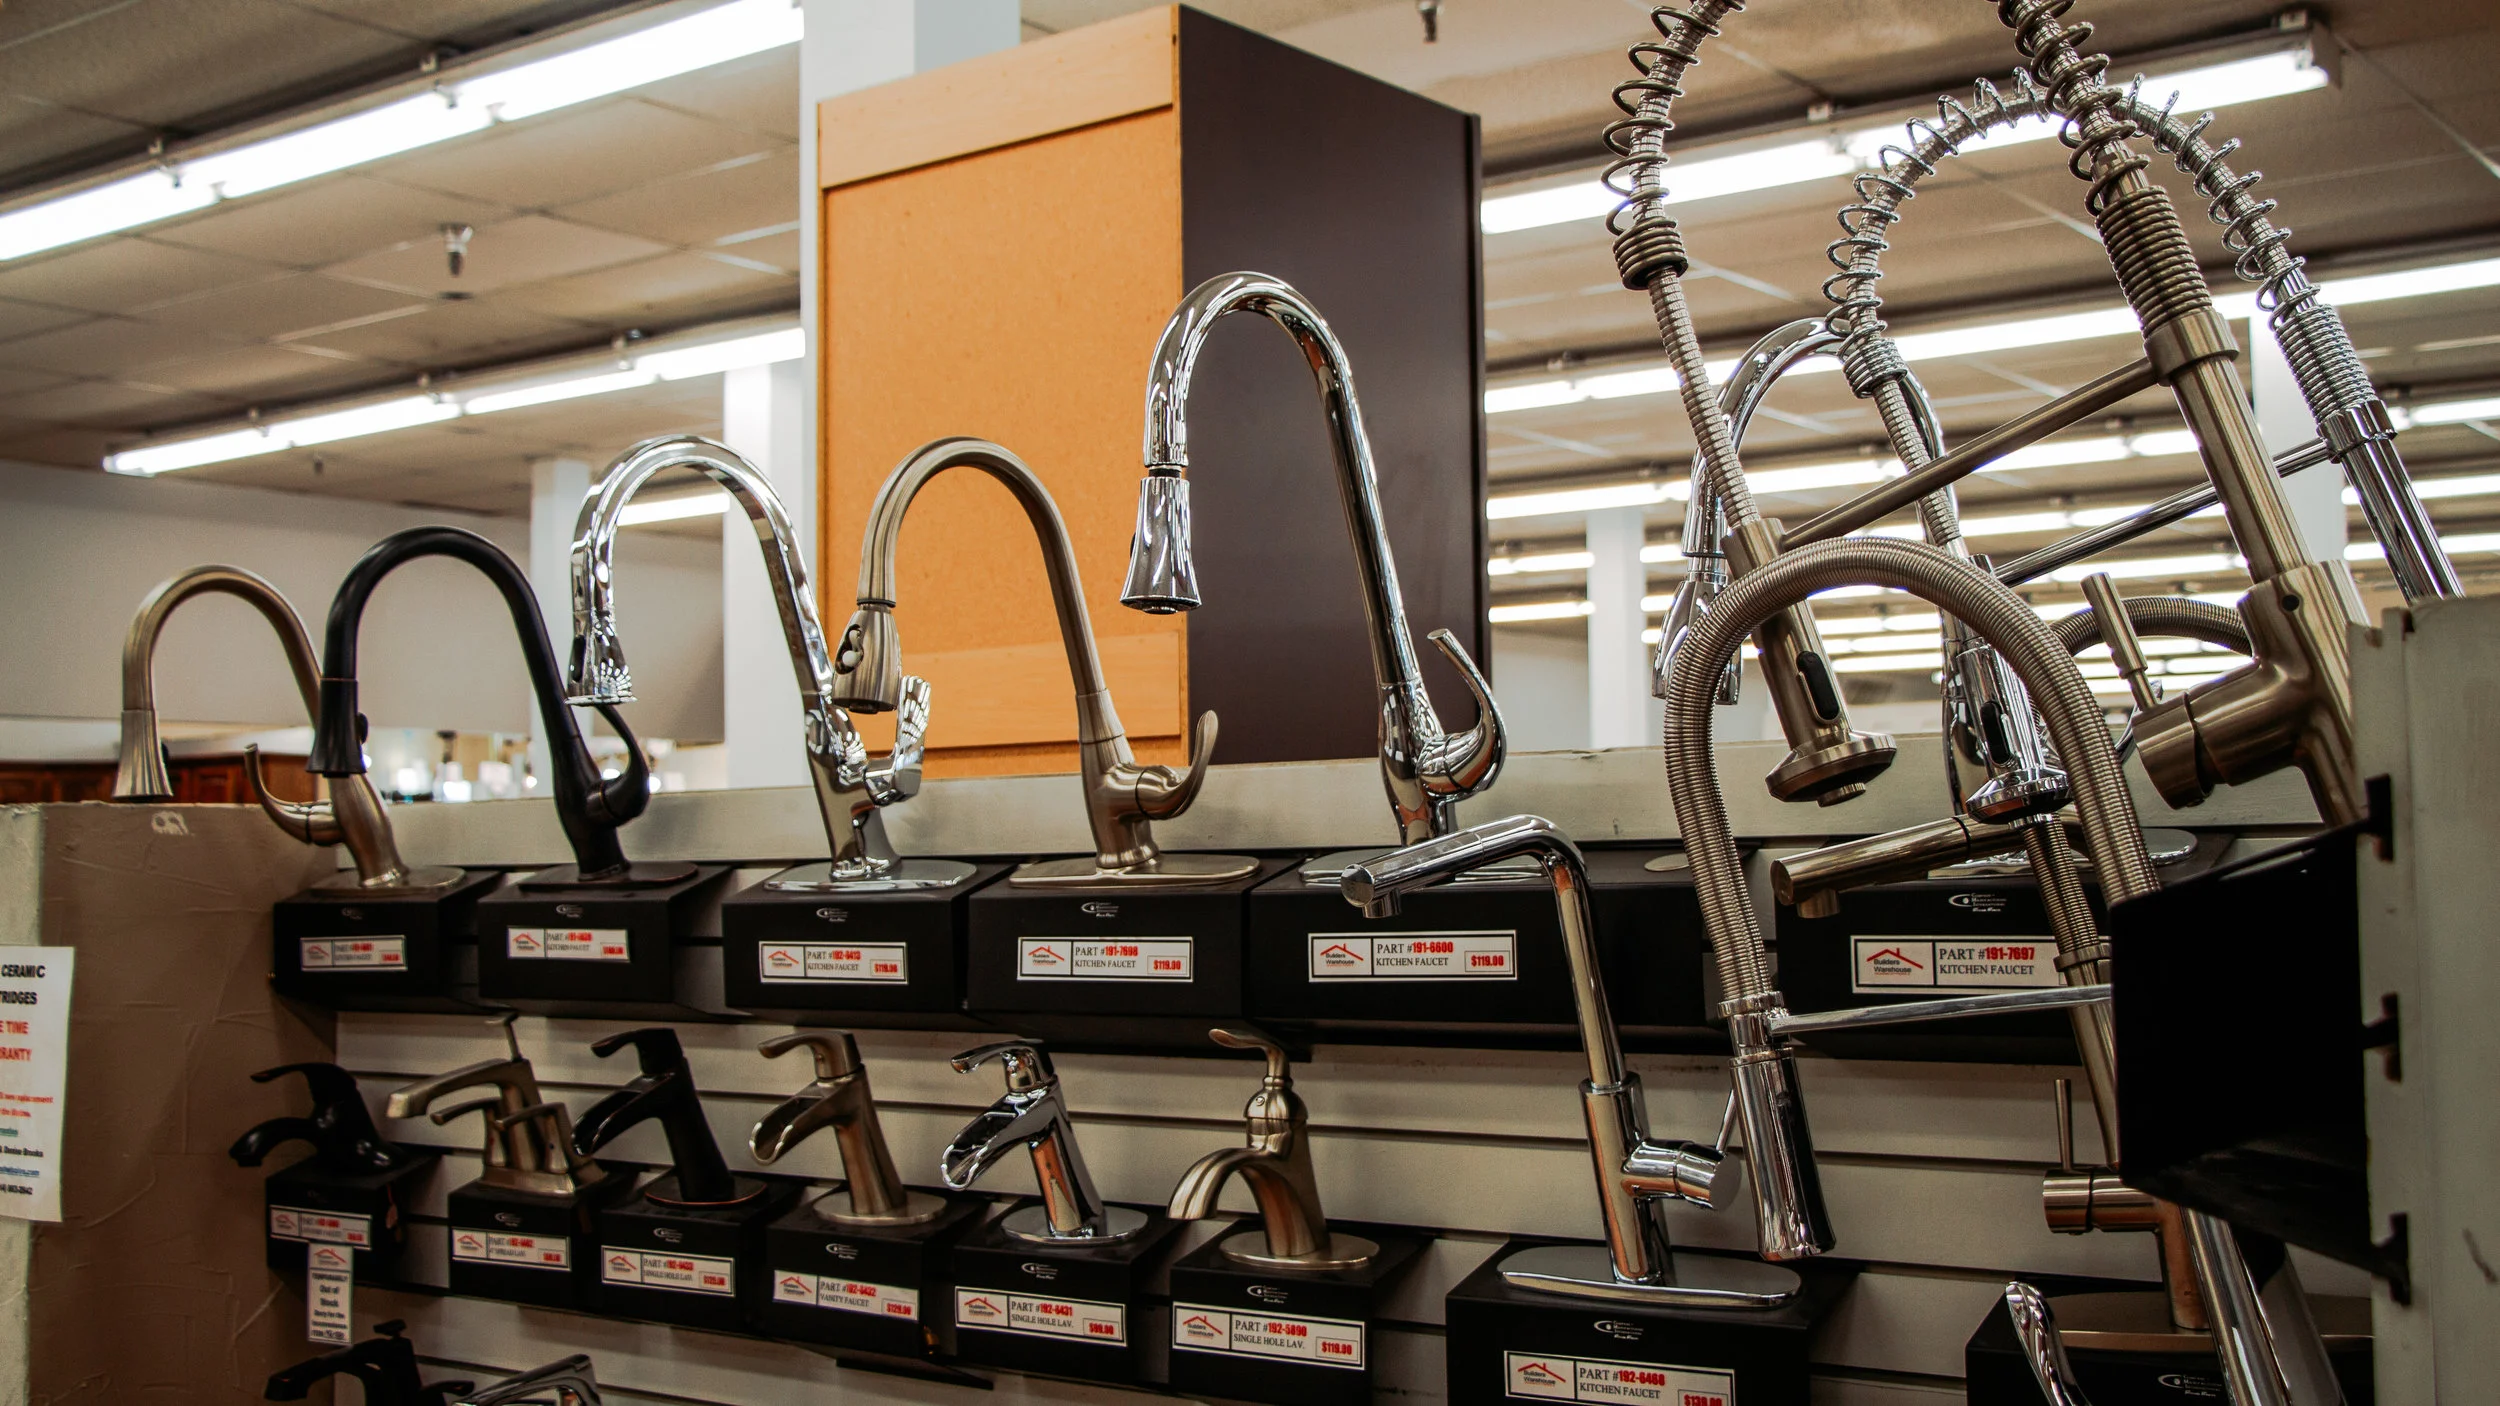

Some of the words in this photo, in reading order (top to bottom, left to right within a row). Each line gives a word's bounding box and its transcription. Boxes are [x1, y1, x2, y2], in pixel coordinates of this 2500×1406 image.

[1075, 947, 1098, 956] PART
[1377, 943, 1404, 954] PART
[1407, 942, 1454, 954] #191-6600
[1939, 948, 1974, 960] PART
[1978, 947, 2035, 960] #191-7697
[807, 951, 826, 960] PART
[1376, 957, 1413, 966] KITCHEN
[1415, 957, 1449, 966] FAUCET
[1075, 960, 1106, 968] KITCHEN
[1107, 960, 1136, 968] FAUCET
[1939, 964, 1988, 974] KITCHEN
[1990, 965, 2034, 975] FAUCET
[1, 964, 46, 978] CERAMIC
[644, 1258, 662, 1268] PART
[820, 1281, 840, 1292] PART
[820, 1293, 843, 1304] VANITY
[844, 1296, 870, 1307] FAUCET
[1011, 1301, 1033, 1312] PART
[1011, 1314, 1036, 1324] SINGLE
[1037, 1317, 1056, 1326] HOLE
[1057, 1319, 1074, 1328] LAV.
[1235, 1320, 1261, 1332] PART
[1234, 1334, 1262, 1345] SINGLE
[1264, 1337, 1285, 1347] HOLE
[1287, 1339, 1305, 1349] LAV.
[1579, 1368, 1610, 1381] PART
[1580, 1382, 1622, 1397] KITCHEN
[1623, 1386, 1661, 1399] FAUCET
